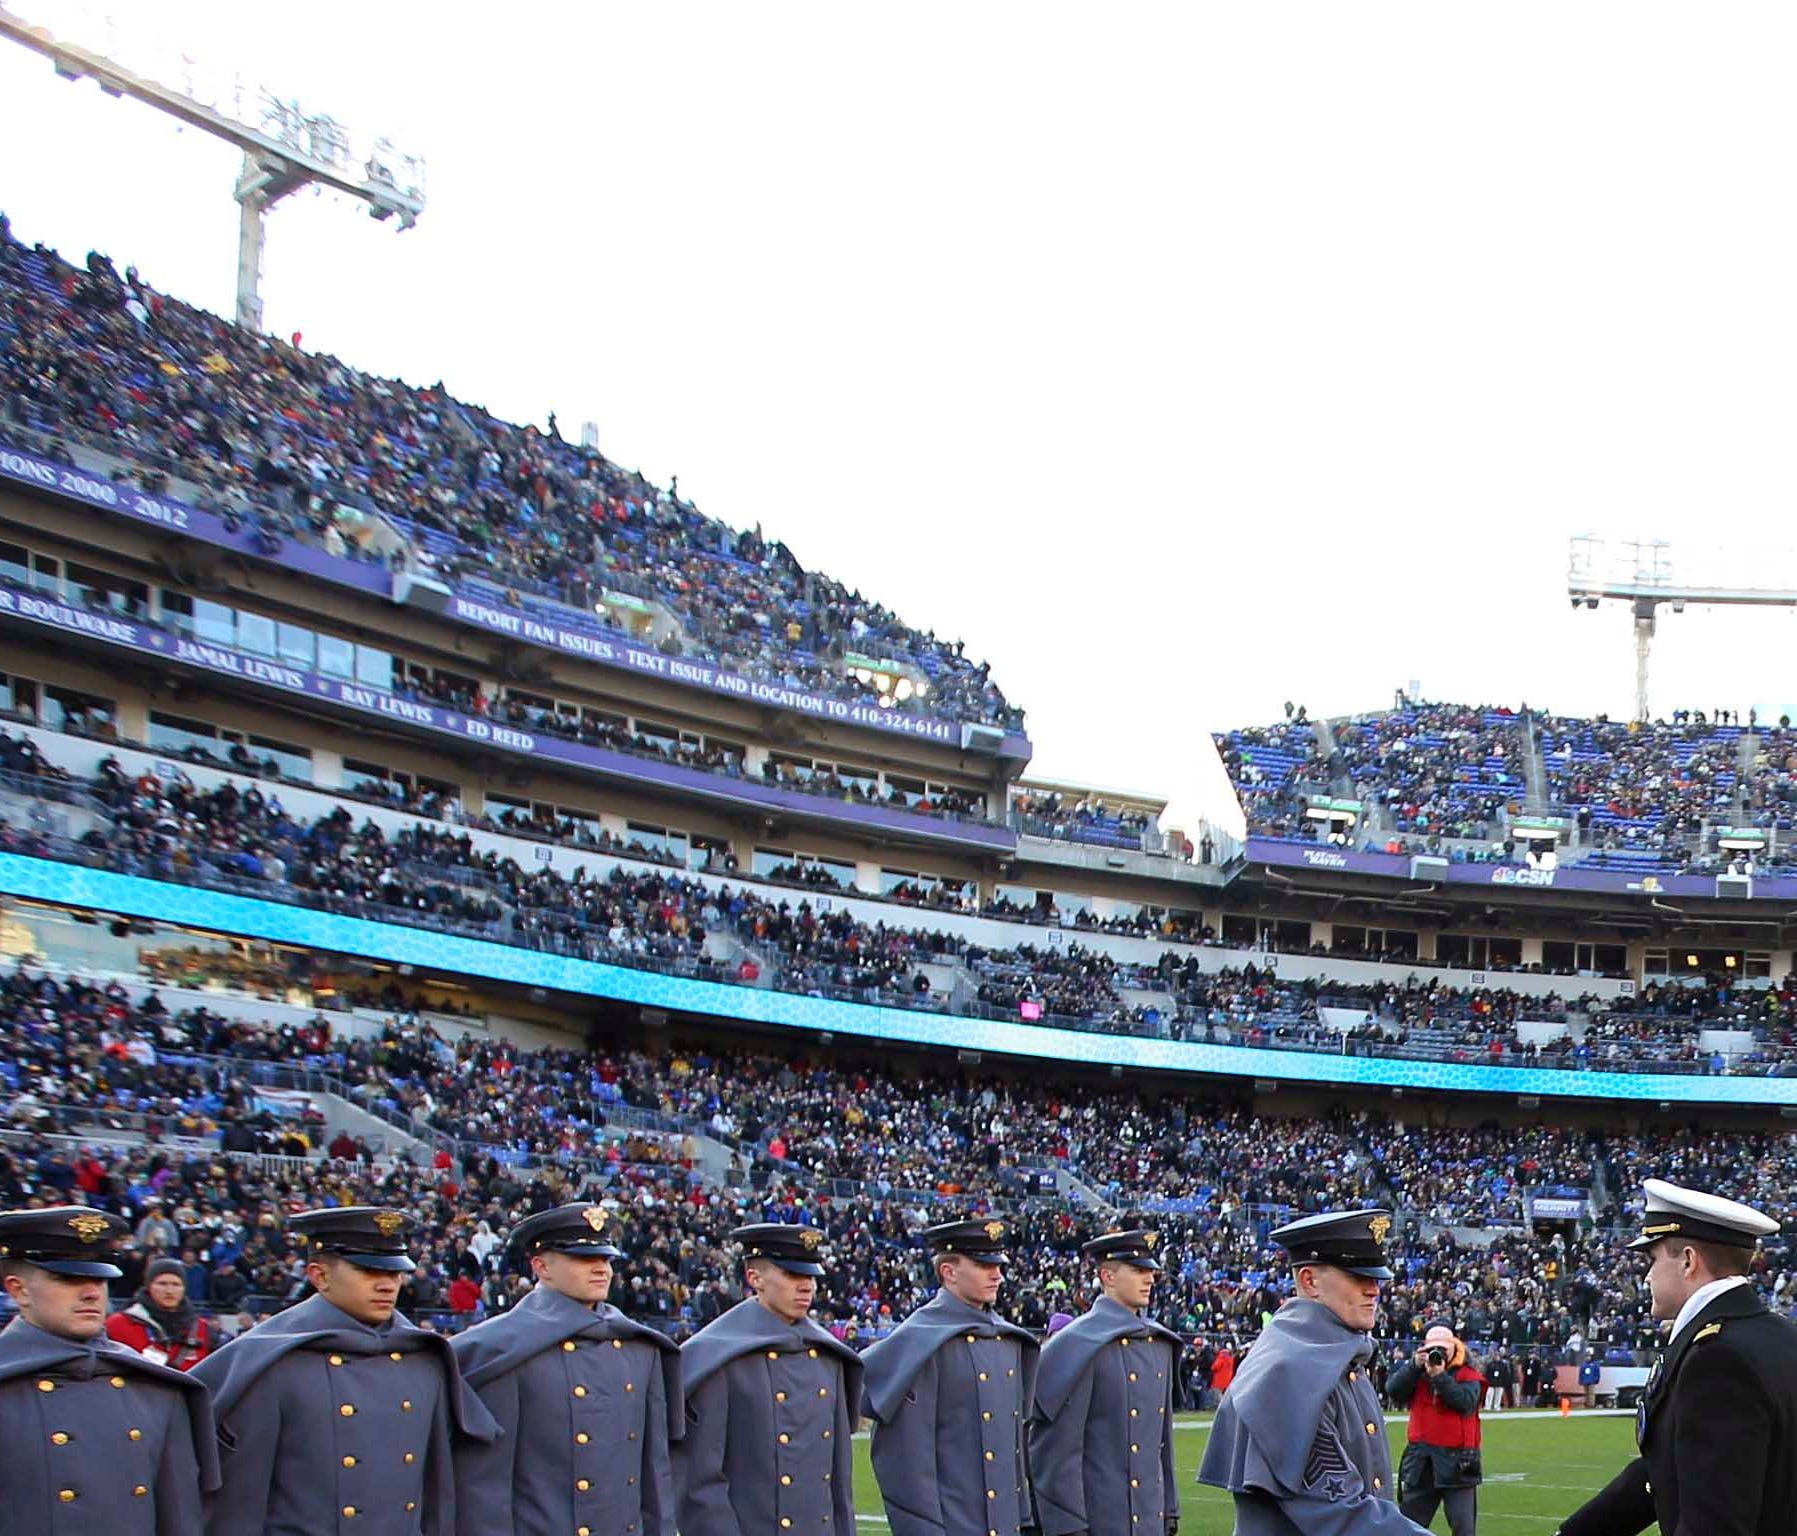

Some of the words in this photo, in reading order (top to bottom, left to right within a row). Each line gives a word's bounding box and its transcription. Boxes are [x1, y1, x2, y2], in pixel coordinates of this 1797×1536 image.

[59, 472, 118, 505] 2000
[133, 495, 189, 529] 2012
[18, 594, 137, 641] BOULWARE
[177, 640, 241, 674] JAMAL
[245, 656, 304, 690] LEWIS
[341, 680, 374, 706] RAY
[378, 694, 434, 723] LEWIS
[466, 720, 488, 738] ED
[492, 726, 534, 751] REED
[457, 599, 520, 633] REPORT
[524, 620, 554, 643] FAN
[559, 631, 614, 659] ISSUES
[626, 648, 666, 673] TEXT
[669, 660, 712, 684] ISSUE
[715, 673, 748, 693] AND
[751, 680, 824, 713] LOCATION
[827, 701, 847, 717] TO
[850, 705, 949, 739] 410-324-6141
[1515, 869, 1556, 885] CSN
